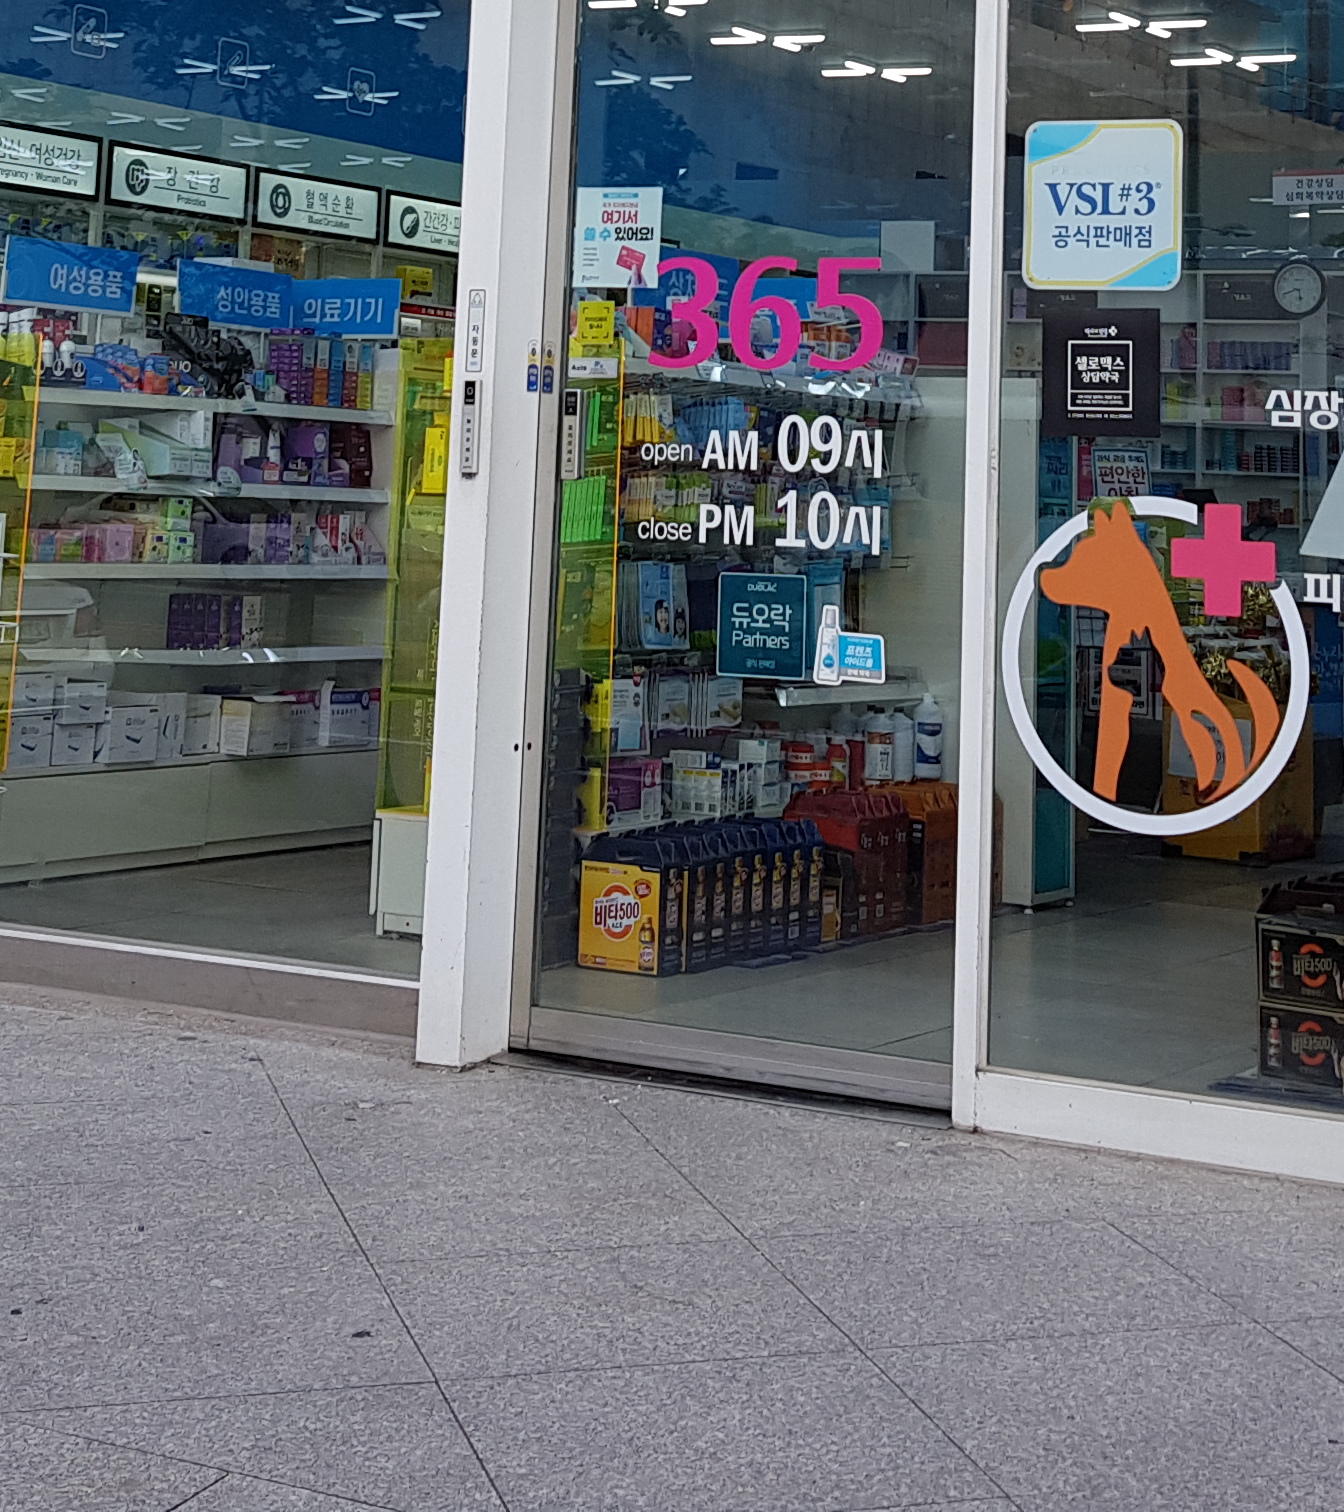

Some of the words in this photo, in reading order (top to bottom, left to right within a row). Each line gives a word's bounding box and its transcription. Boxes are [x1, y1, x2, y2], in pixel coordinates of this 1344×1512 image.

[61, 175, 78, 187] Care
[1295, 177, 1335, 189] 건강상담
[601, 210, 639, 225] 여기서
[598, 226, 612, 242] 수
[614, 226, 654, 242] 있어요!
[1051, 223, 1154, 249] 공식판매점
[49, 262, 124, 299] 여성용품
[216, 284, 281, 319] 성인용품
[302, 297, 384, 325] 의료기기
[648, 256, 884, 371] 365
[1074, 355, 1126, 371] 셀로맥스
[1080, 370, 1120, 384] 상담약국
[640, 441, 694, 468] open
[701, 429, 760, 472] AM
[777, 414, 883, 479] 09시
[1097, 464, 1146, 485] 편안한
[636, 517, 693, 543] close
[697, 503, 755, 547] PM
[774, 489, 882, 556] 10시
[730, 602, 793, 633] 듀오락
[731, 630, 790, 649] Partners
[593, 901, 641, 927] 비타500
